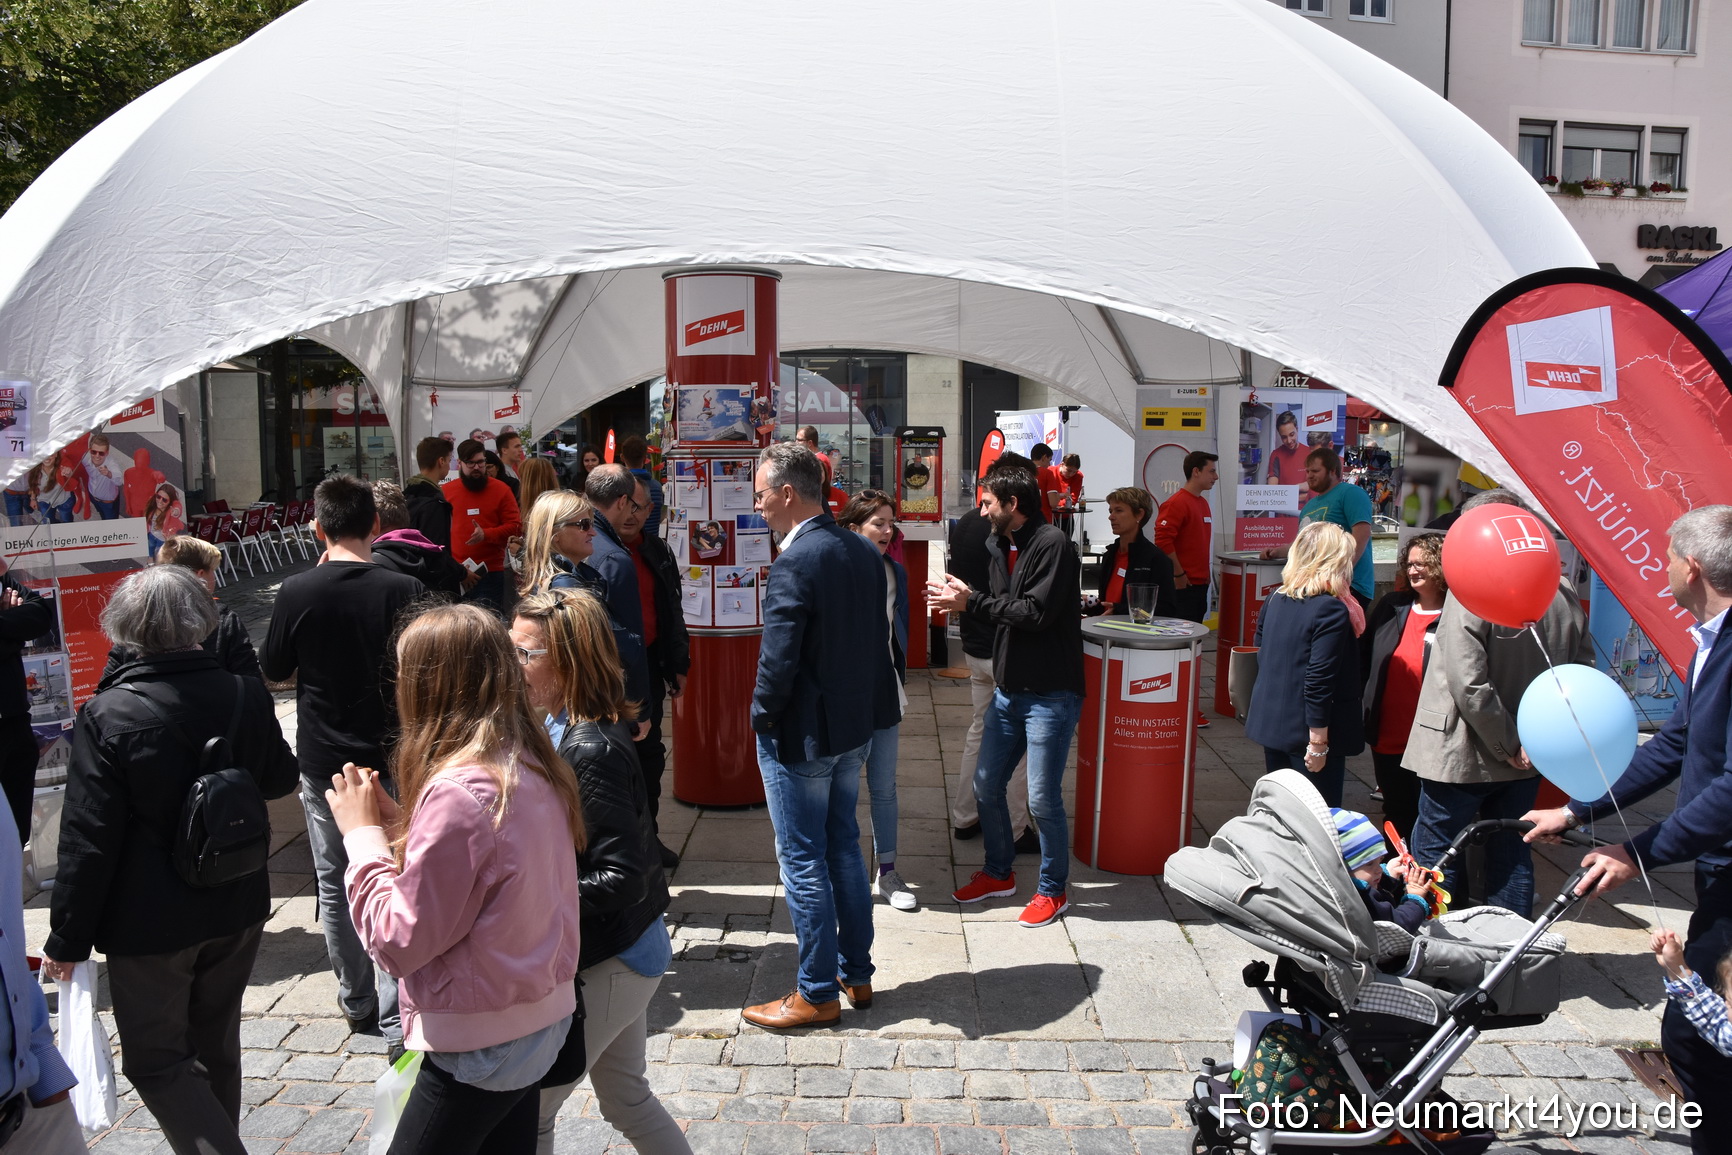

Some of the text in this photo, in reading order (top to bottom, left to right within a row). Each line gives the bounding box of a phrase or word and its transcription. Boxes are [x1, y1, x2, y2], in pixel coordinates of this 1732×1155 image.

[1637, 224, 1723, 251] RACKL
[1646, 255, 1664, 263] am
[700, 320, 728, 336] DEHN
[942, 380, 952, 388] 22
[783, 391, 859, 413] SALE
[122, 406, 143, 418] DEHN
[11, 440, 24, 452] 71
[1245, 489, 1288, 497] DEHN INSTATEC
[5, 540, 34, 550] DEHN
[80, 534, 100, 545] Weg
[80, 585, 100, 593] SÖHNE
[1141, 679, 1162, 690] DEHN
[1114, 716, 1181, 728] DEHN INSTATEC
[1114, 728, 1180, 739] Alles mit Strom.
